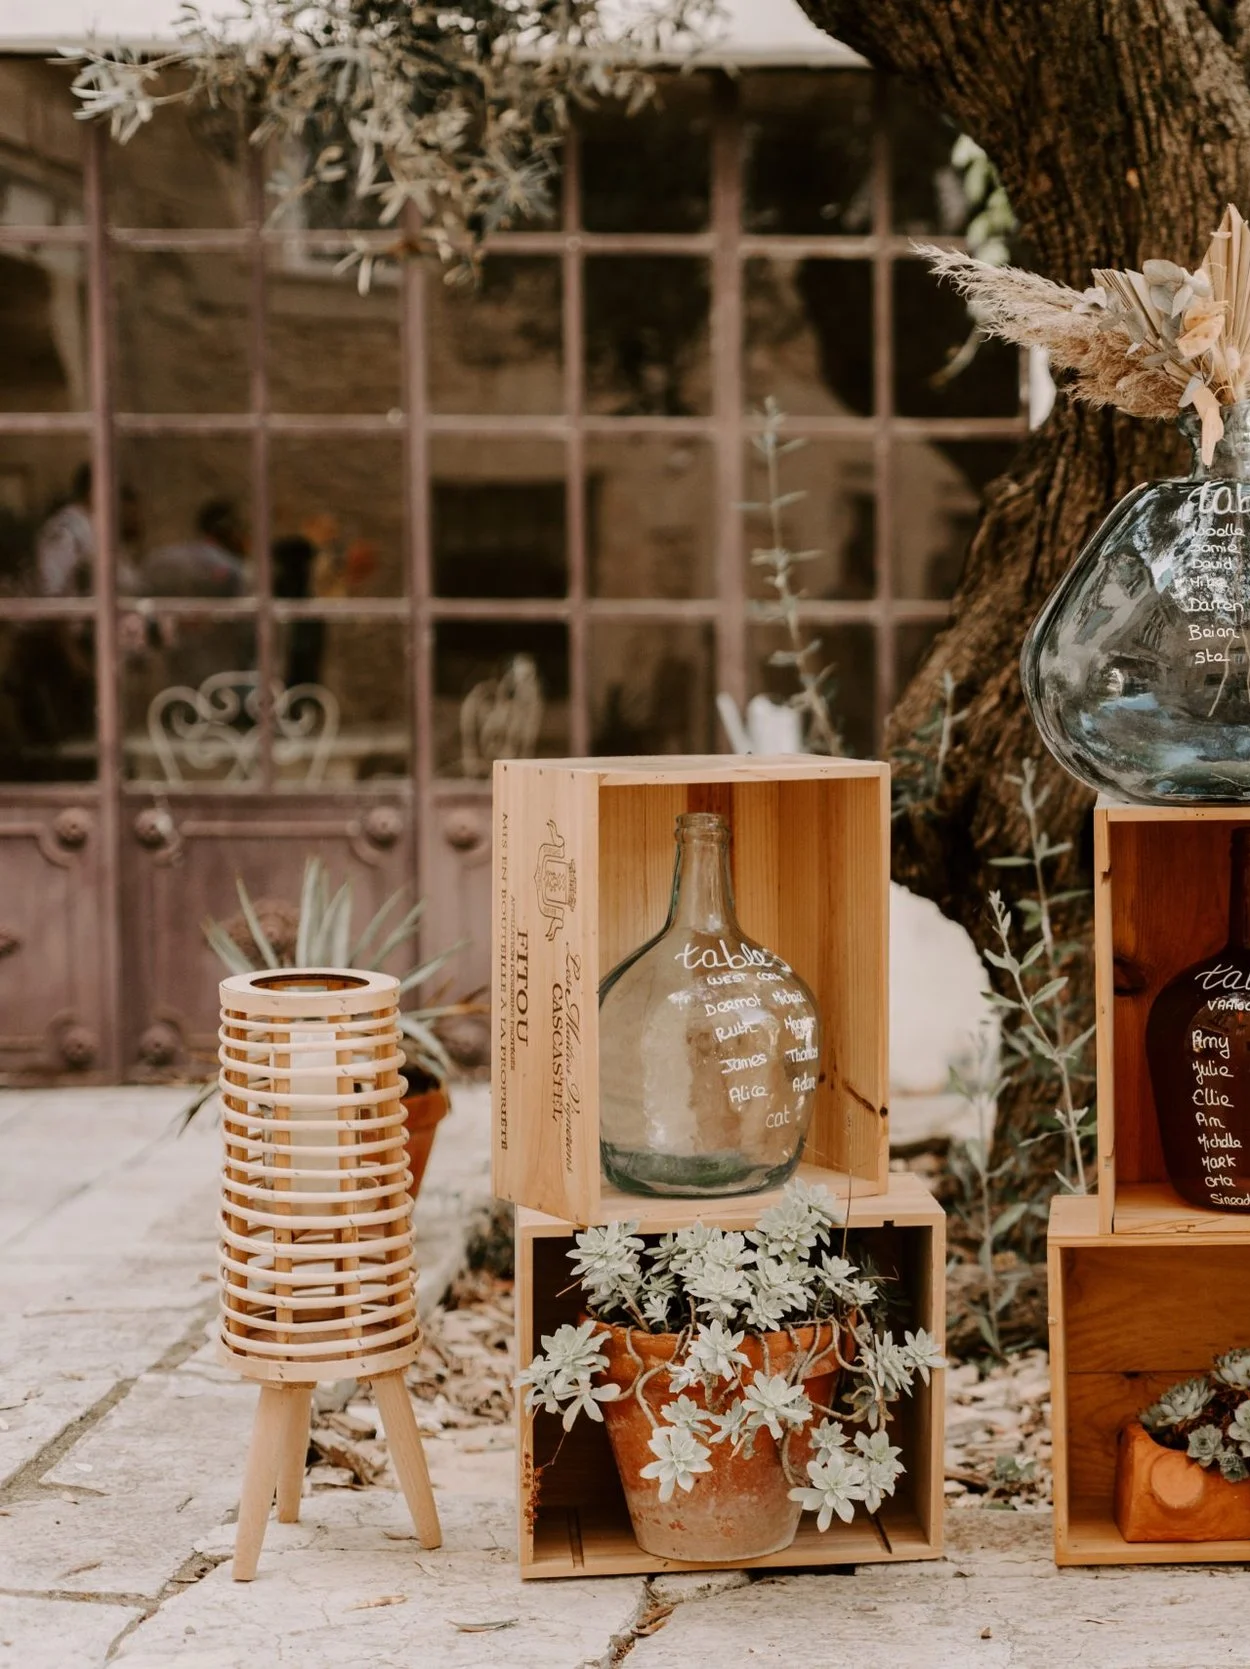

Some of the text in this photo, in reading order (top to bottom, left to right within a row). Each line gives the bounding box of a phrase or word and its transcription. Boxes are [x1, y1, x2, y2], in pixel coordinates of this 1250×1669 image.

[1193, 523, 1246, 537] Noelle
[1188, 542, 1241, 554] Jamie
[1192, 556, 1233, 570] David
[1186, 597, 1244, 612] Darren
[1188, 624, 1240, 641] Brian
[501, 856, 508, 881] EN
[674, 939, 773, 969] table
[516, 928, 529, 1047] FITOU
[706, 972, 748, 985] WEST
[705, 992, 762, 1017] Dermot
[500, 1017, 507, 1041] LA
[715, 1020, 759, 1043] Ruth
[552, 982, 563, 1122] CASCASTEL
[1192, 1029, 1230, 1059] Amy
[719, 1052, 769, 1074] James
[1192, 1059, 1234, 1085] Julie
[729, 1085, 769, 1103] Alice
[1192, 1087, 1235, 1108] Ellie
[1198, 1132, 1242, 1153] Michelle
[1201, 1154, 1236, 1173] Mark
[1204, 1174, 1236, 1188] Orla
